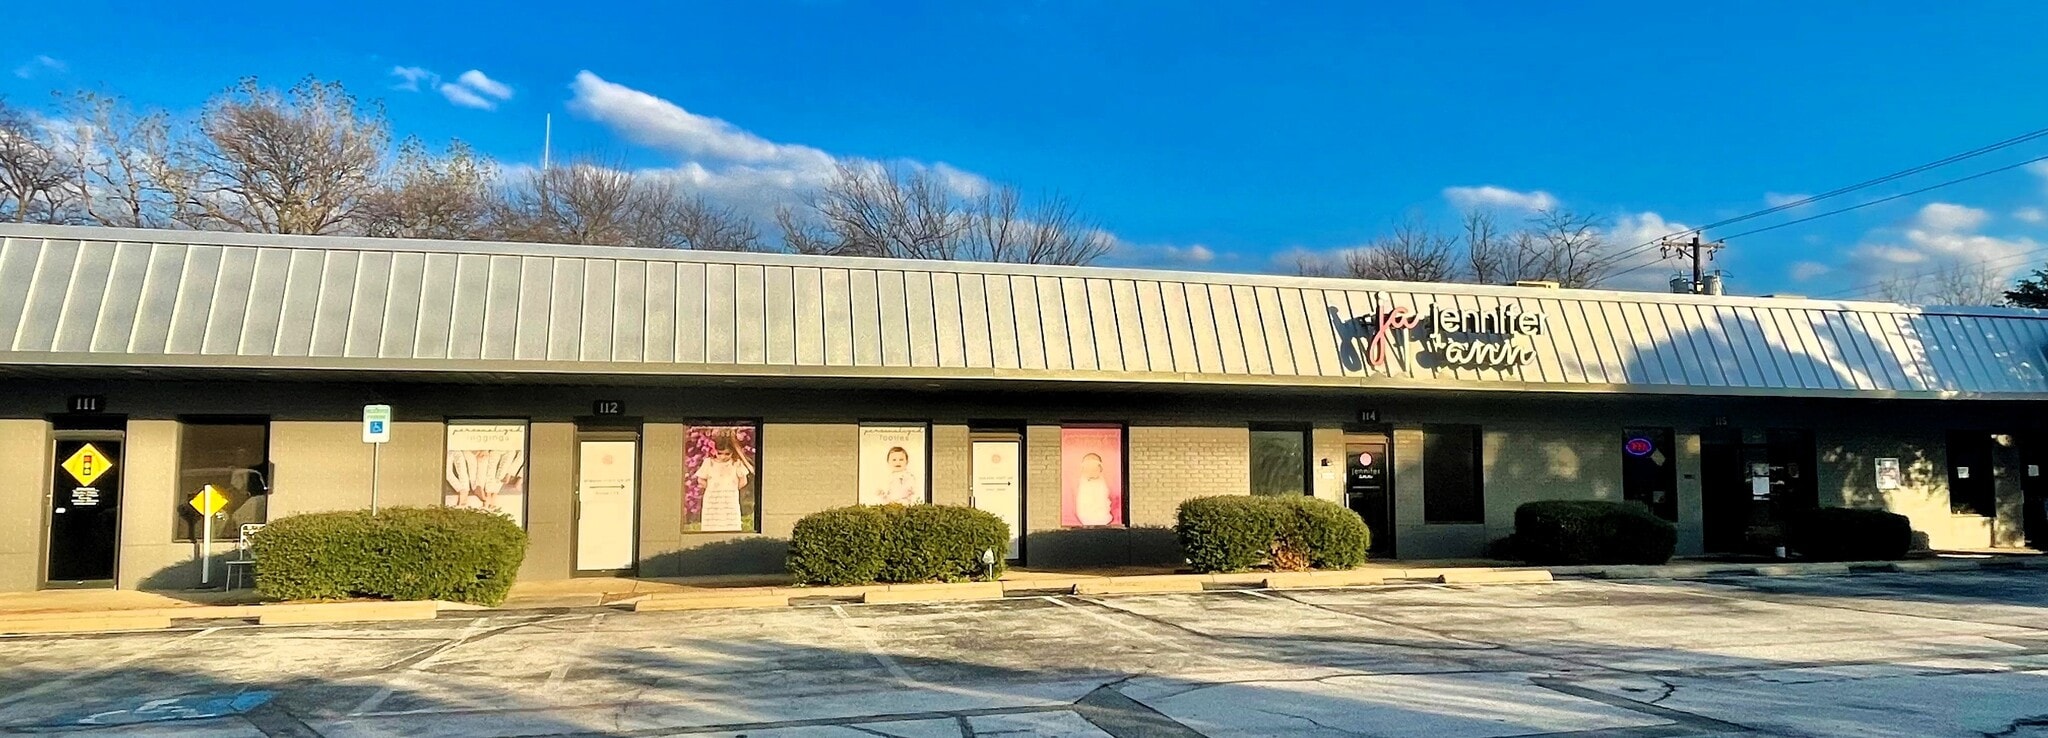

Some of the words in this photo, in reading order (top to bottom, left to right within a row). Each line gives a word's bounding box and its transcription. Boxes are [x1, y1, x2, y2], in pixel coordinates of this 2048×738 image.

[1431, 302, 1549, 338] jennifer
[1446, 338, 1536, 366] ann
[76, 398, 96, 411] 111
[599, 402, 619, 414] 112
[1362, 411, 1376, 421] 114
